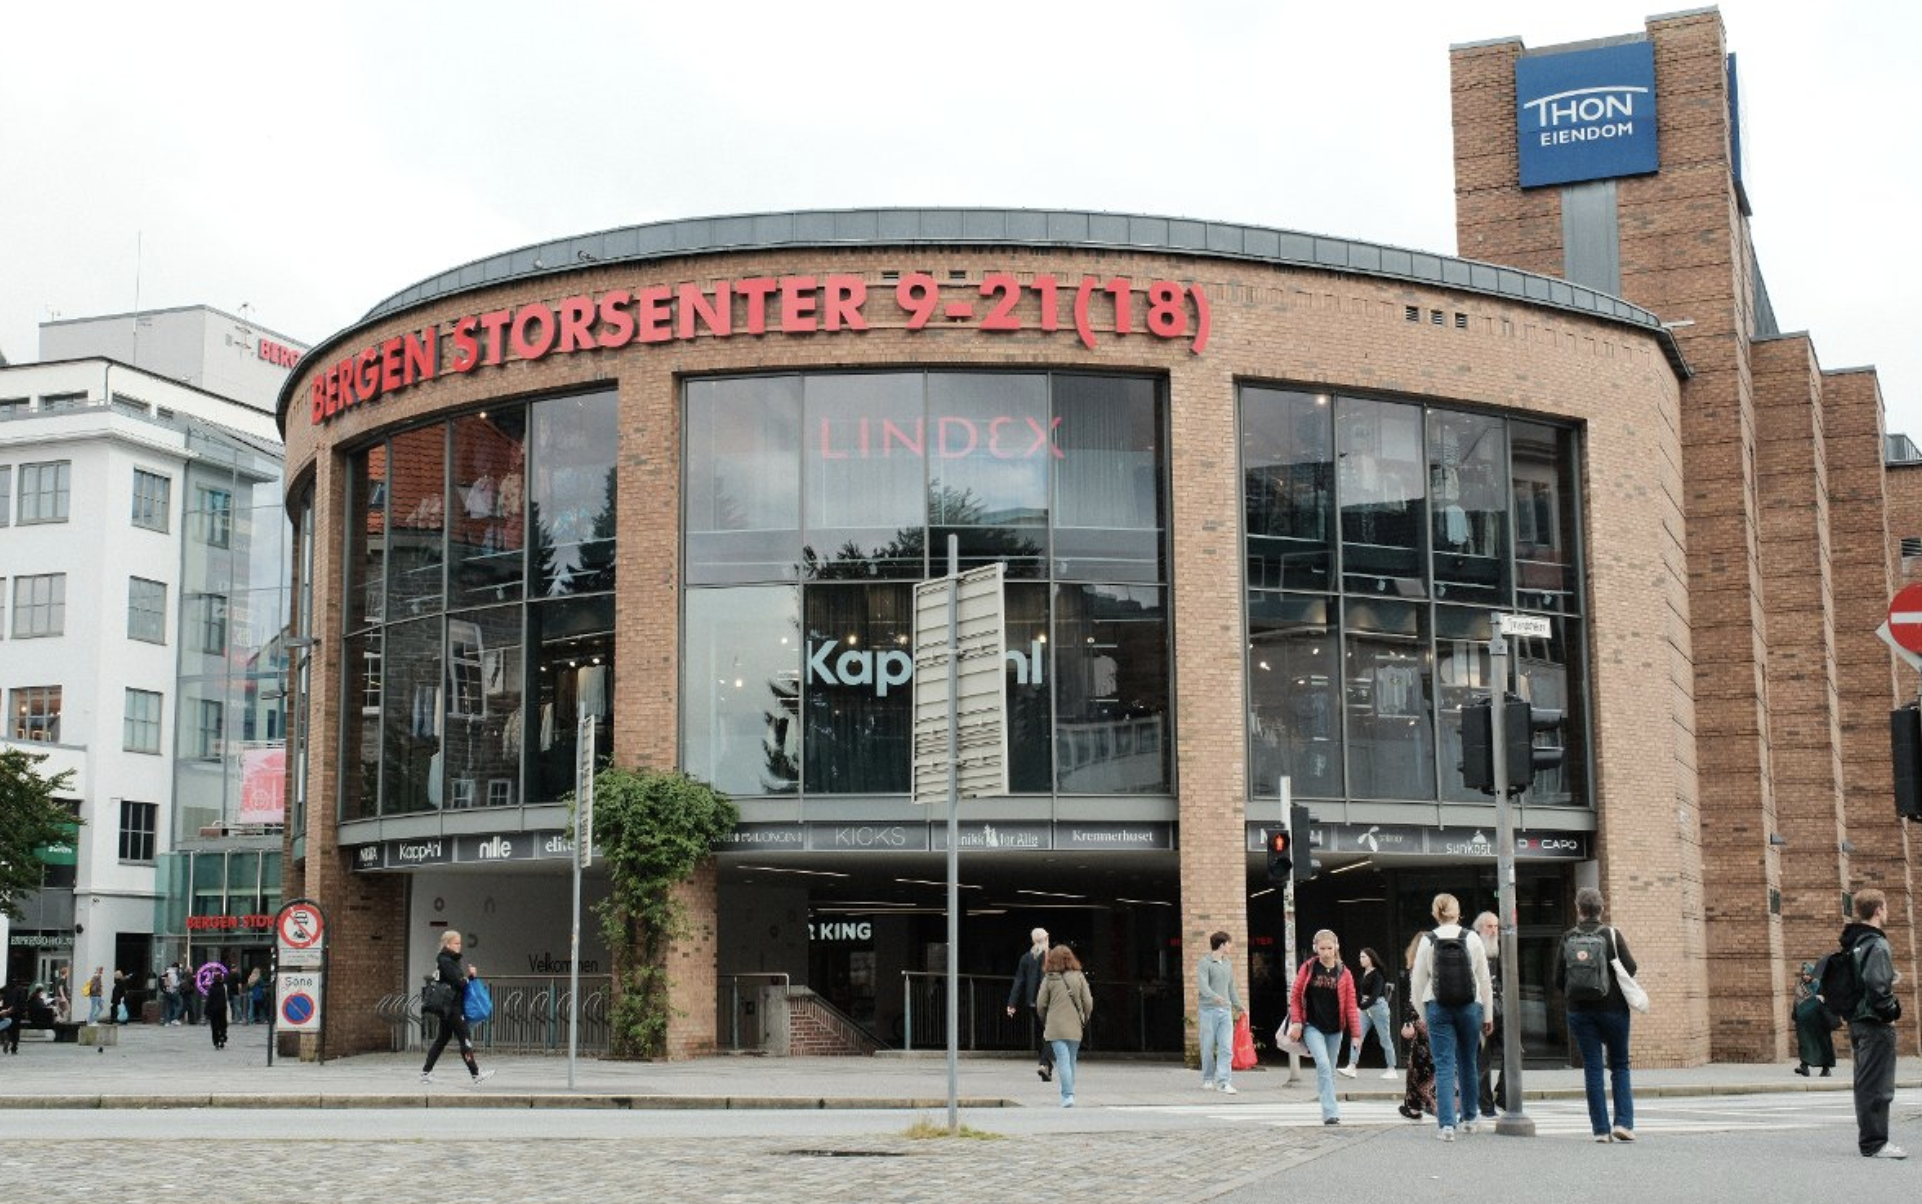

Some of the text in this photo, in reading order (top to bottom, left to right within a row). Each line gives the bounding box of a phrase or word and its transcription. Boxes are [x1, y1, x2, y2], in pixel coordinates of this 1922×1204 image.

[1524, 86, 1648, 127] THON
[1541, 121, 1633, 146] EIENDOM
[312, 272, 1211, 425] BERGEN STORSENTER 9-21(18)
[820, 416, 1065, 459] LINDEX
[835, 826, 906, 846] KICKS
[480, 836, 512, 858] nille
[1446, 840, 1492, 856] sunkost
[186, 915, 239, 929] BERGEN
[820, 922, 872, 940] KING
[285, 976, 313, 987] Sone
